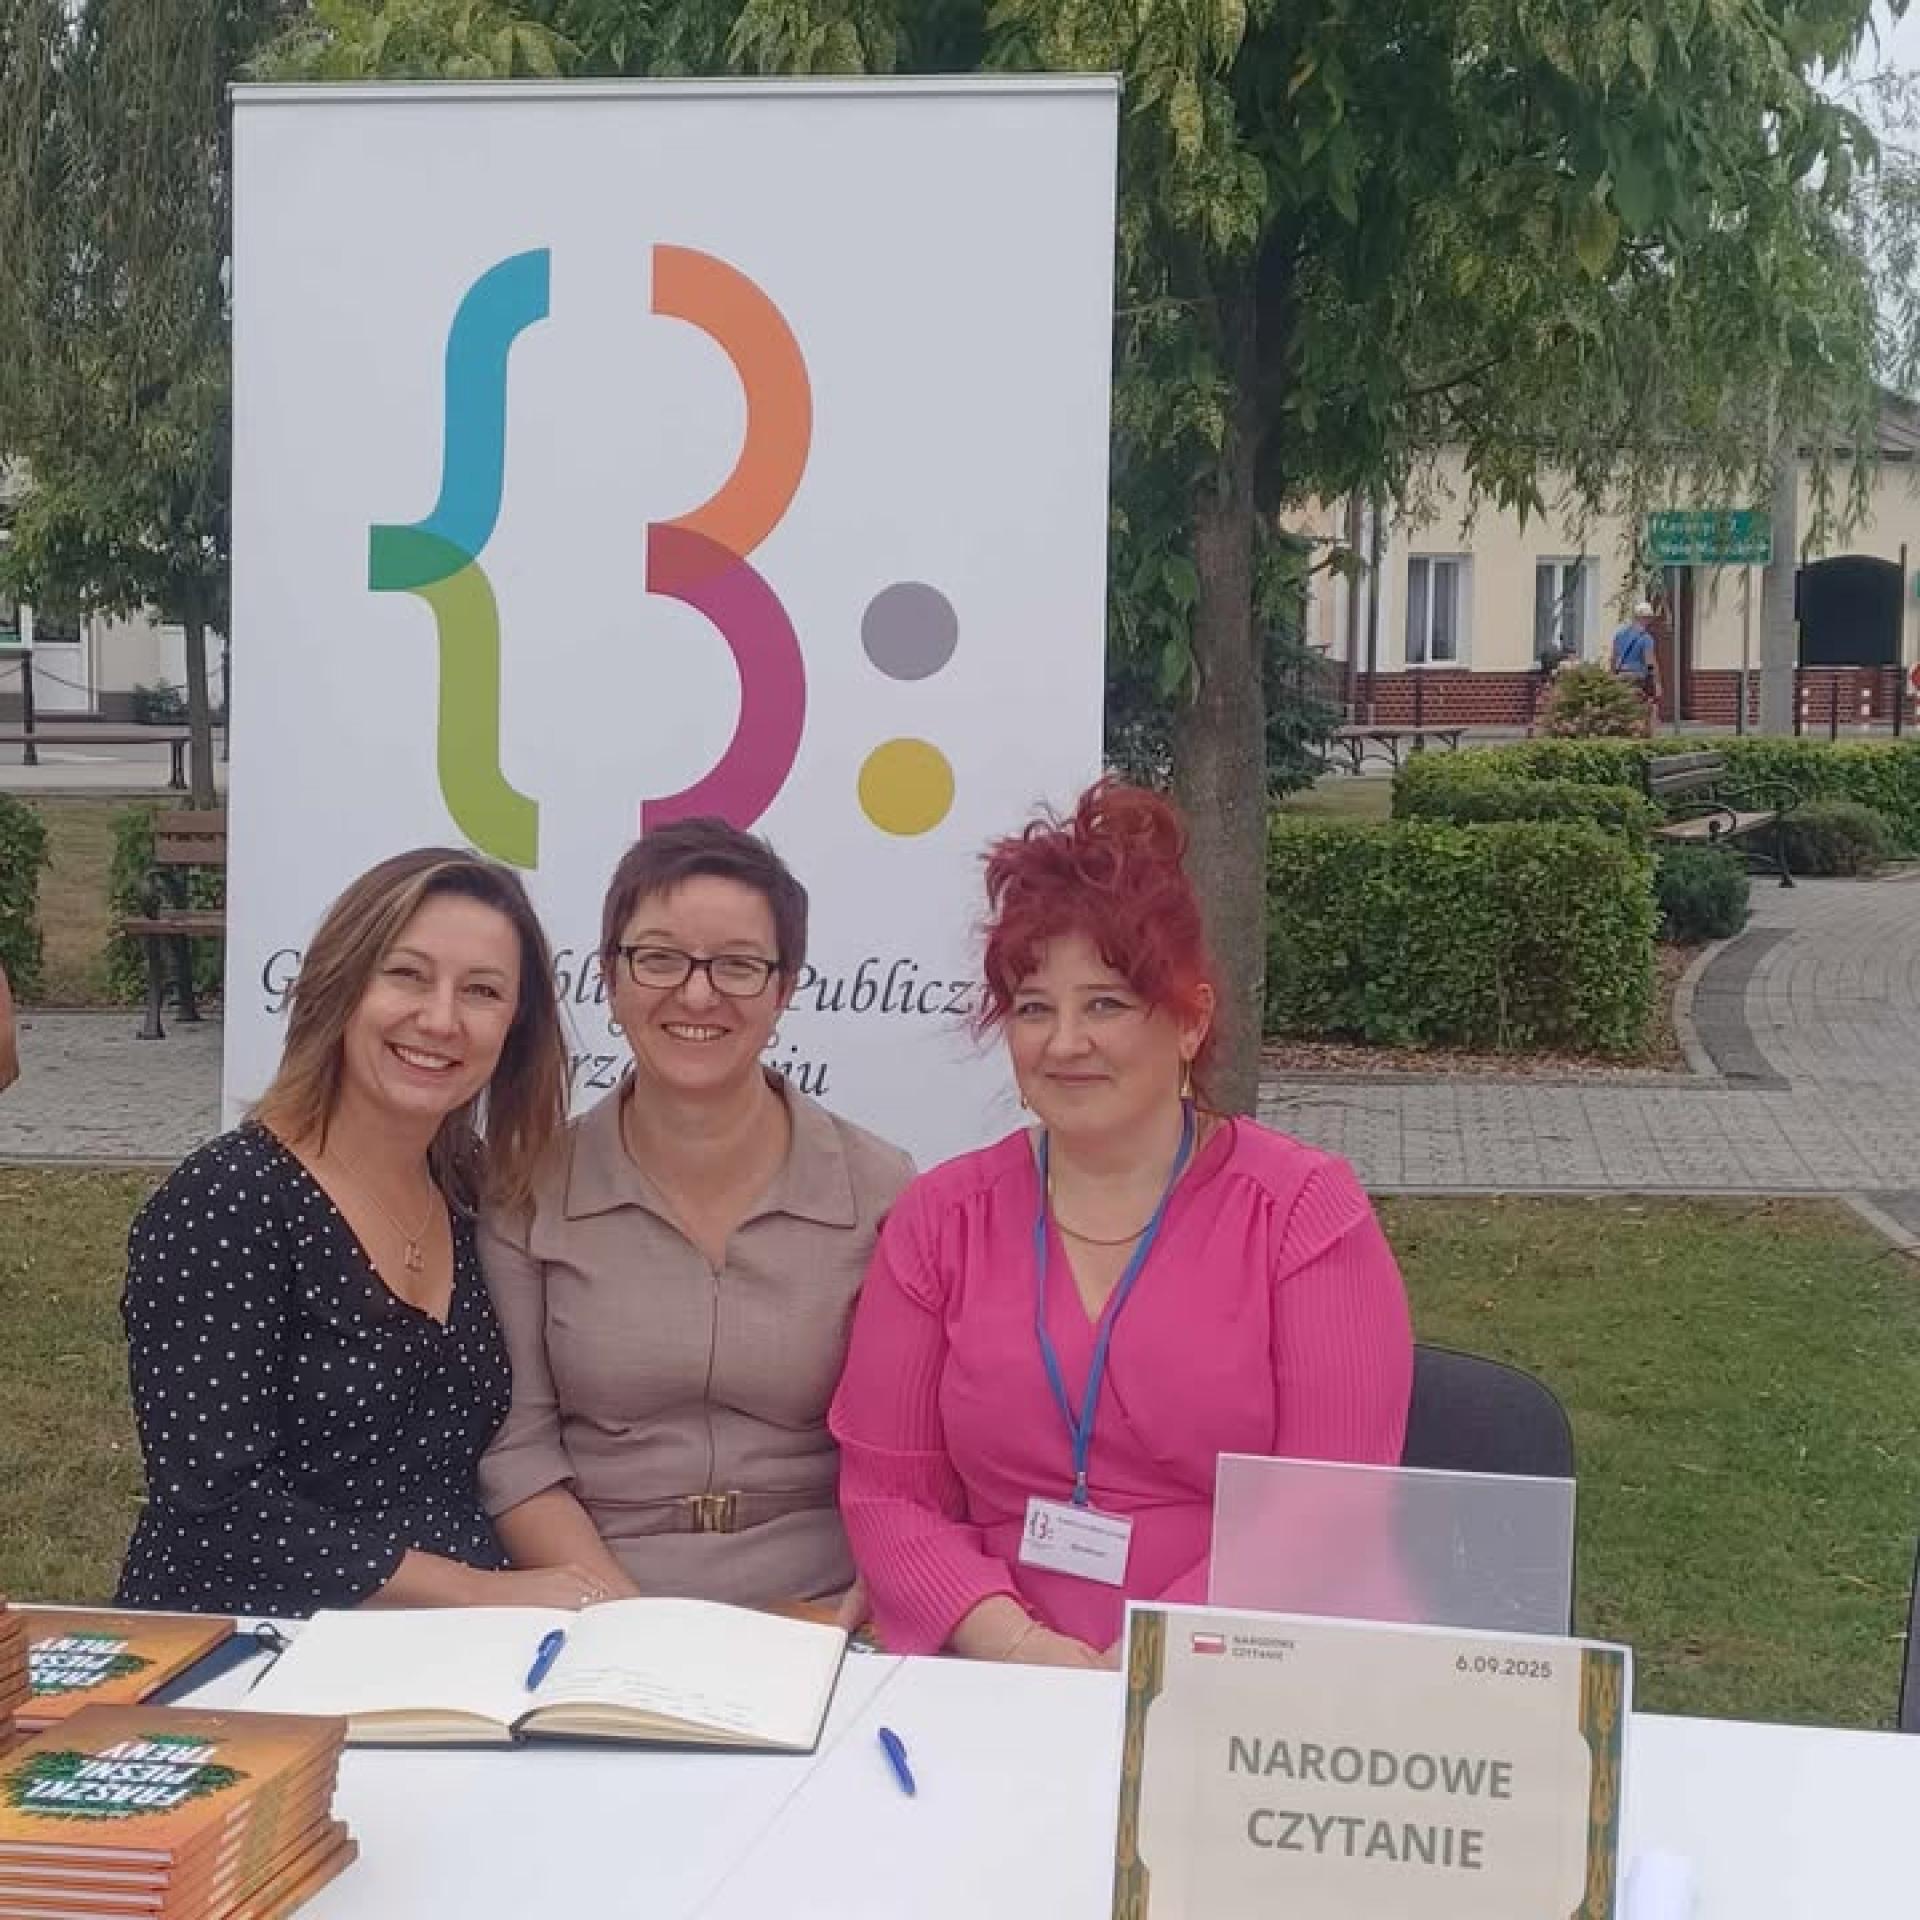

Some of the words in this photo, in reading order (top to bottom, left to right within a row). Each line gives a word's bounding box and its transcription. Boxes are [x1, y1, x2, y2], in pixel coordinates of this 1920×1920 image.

[786, 957, 980, 1014] Publicz
[1455, 1655, 1552, 1678] 6.09.2025
[1228, 1735, 1513, 1799] NARODOWE
[1247, 1807, 1485, 1870] CZYTANIE
